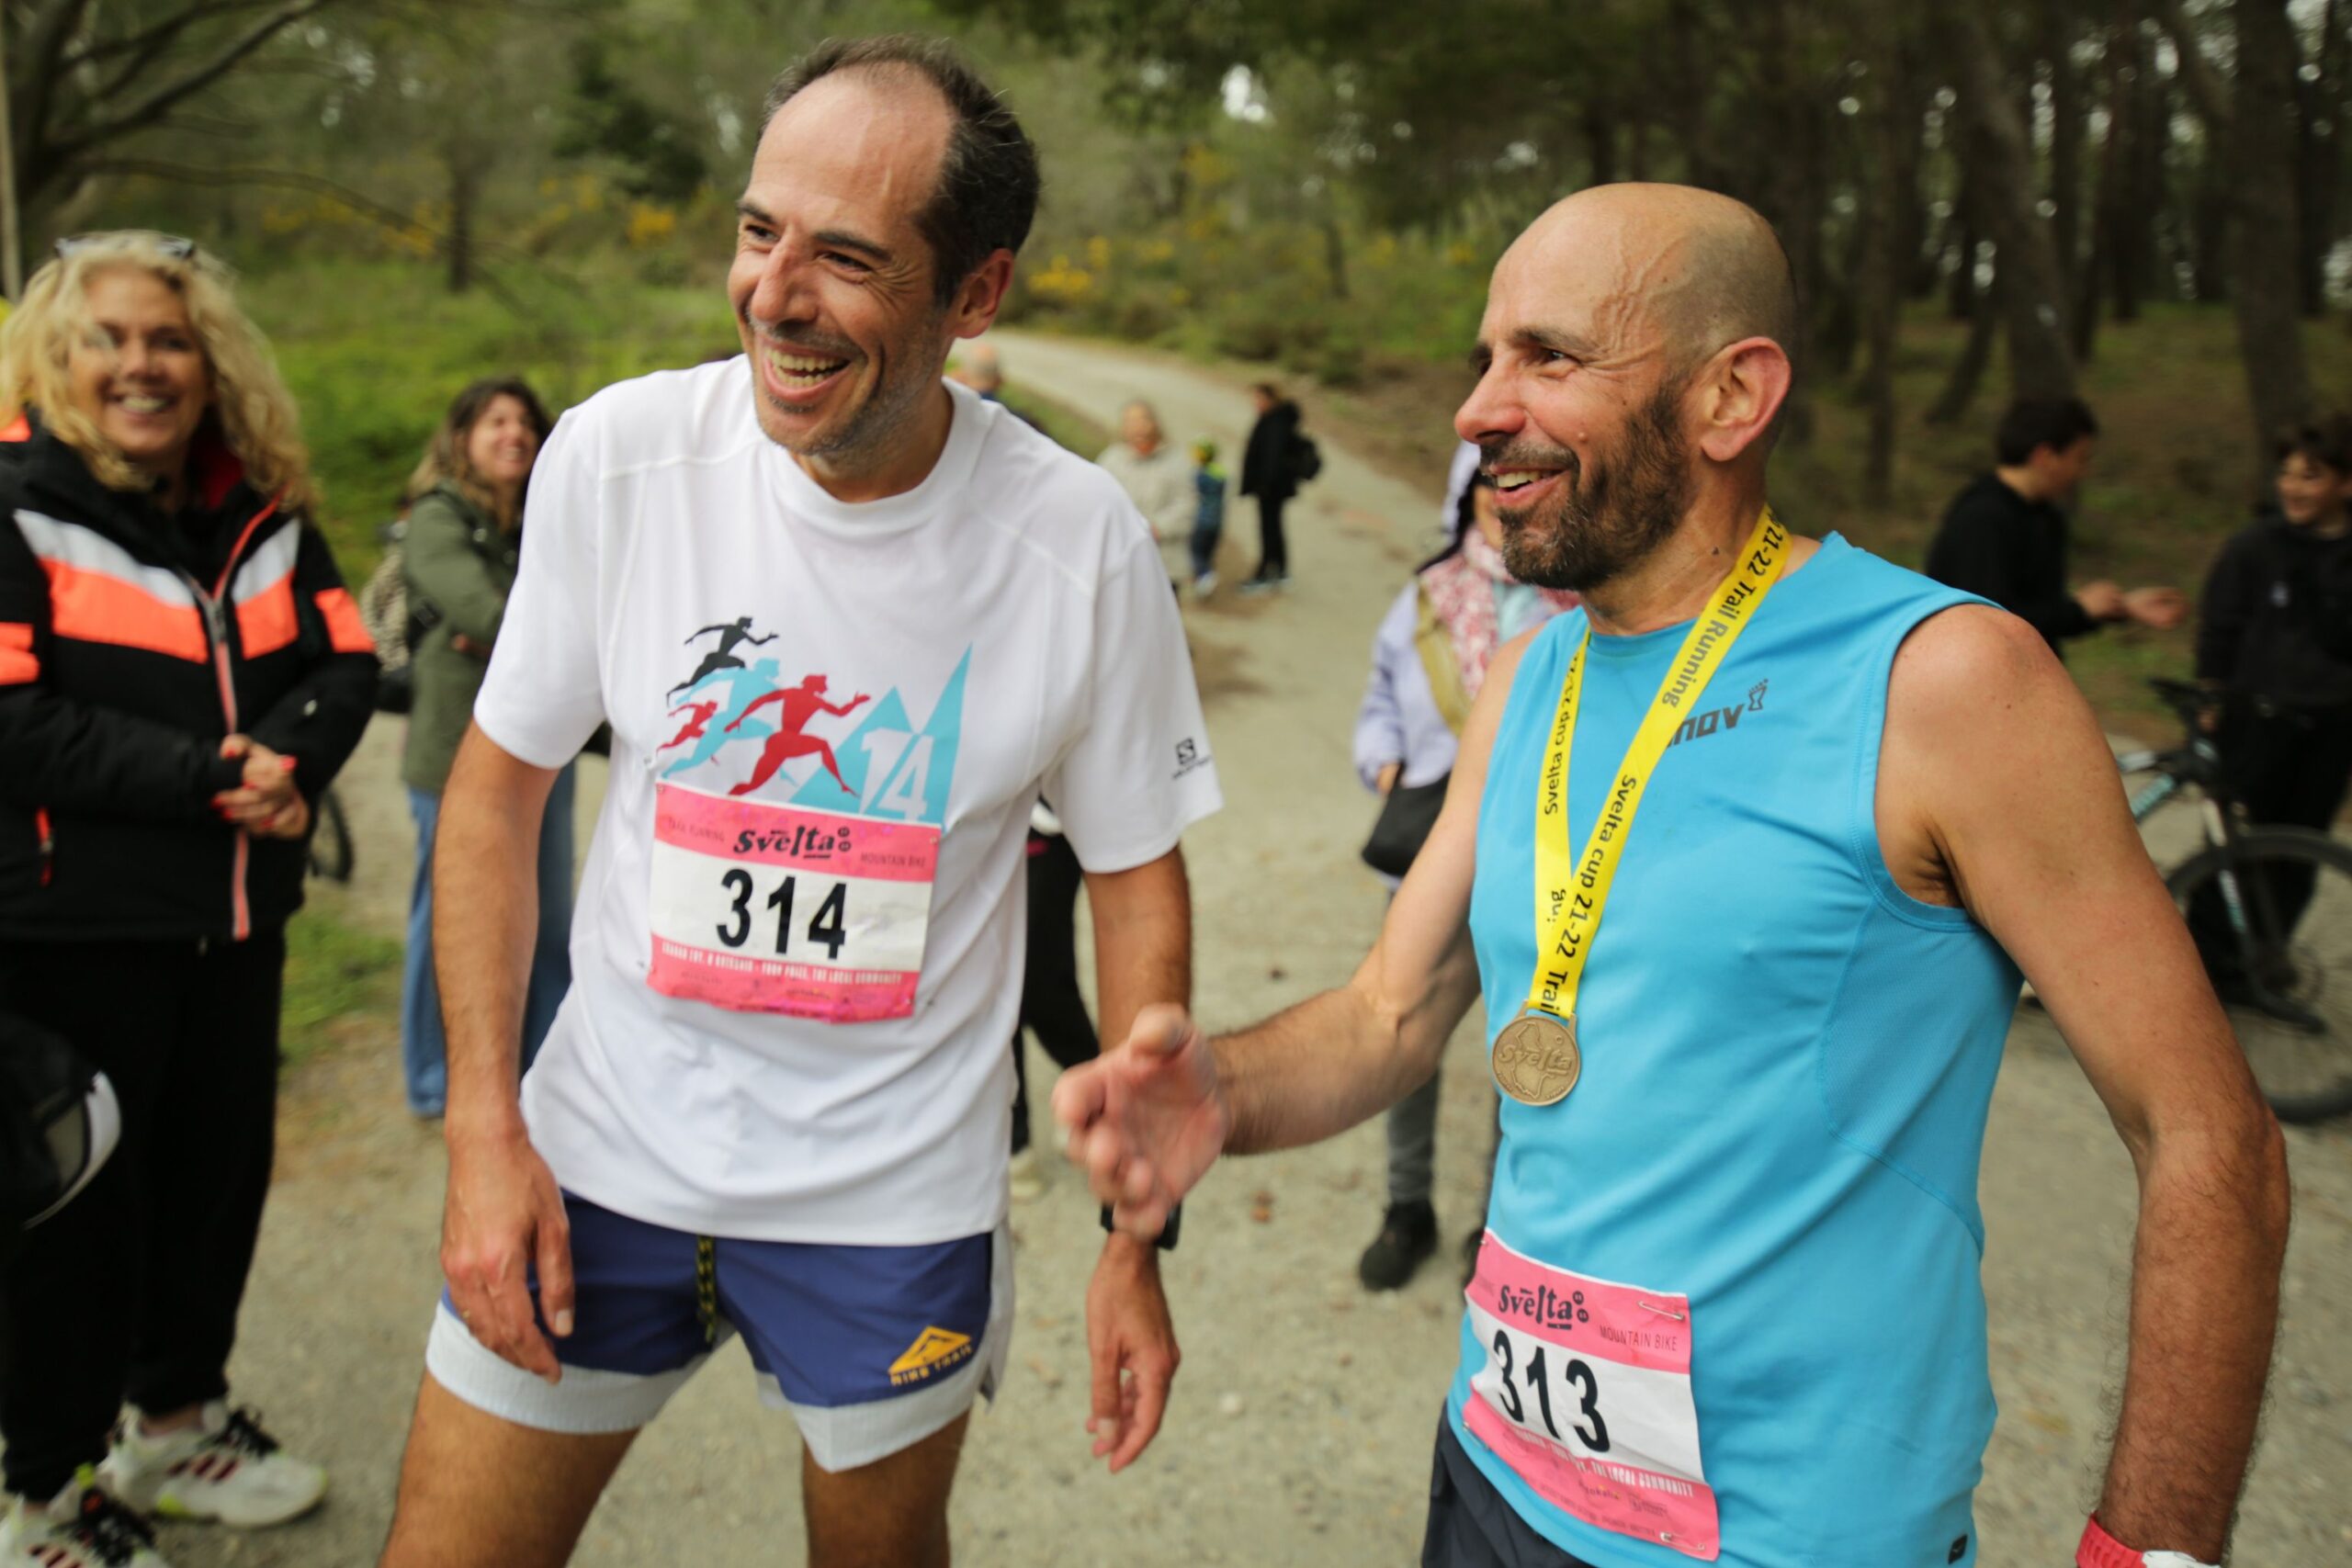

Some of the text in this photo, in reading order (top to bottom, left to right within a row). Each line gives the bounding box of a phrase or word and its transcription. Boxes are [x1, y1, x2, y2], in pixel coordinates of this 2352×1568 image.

[1747, 525, 1783, 577] 21-22
[1718, 580, 1757, 621] Trail
[1661, 619, 1728, 708] Running
[1666, 704, 1745, 749] nov
[1544, 751, 1564, 816] Svelta
[1600, 773, 1637, 843] Svelta
[1579, 849, 1604, 889] cup
[716, 868, 847, 961] 314
[1555, 894, 1593, 959] 21-22
[1599, 1324, 1679, 1352] MOUNTAIN BIKE
[1493, 1329, 1611, 1454] 313
